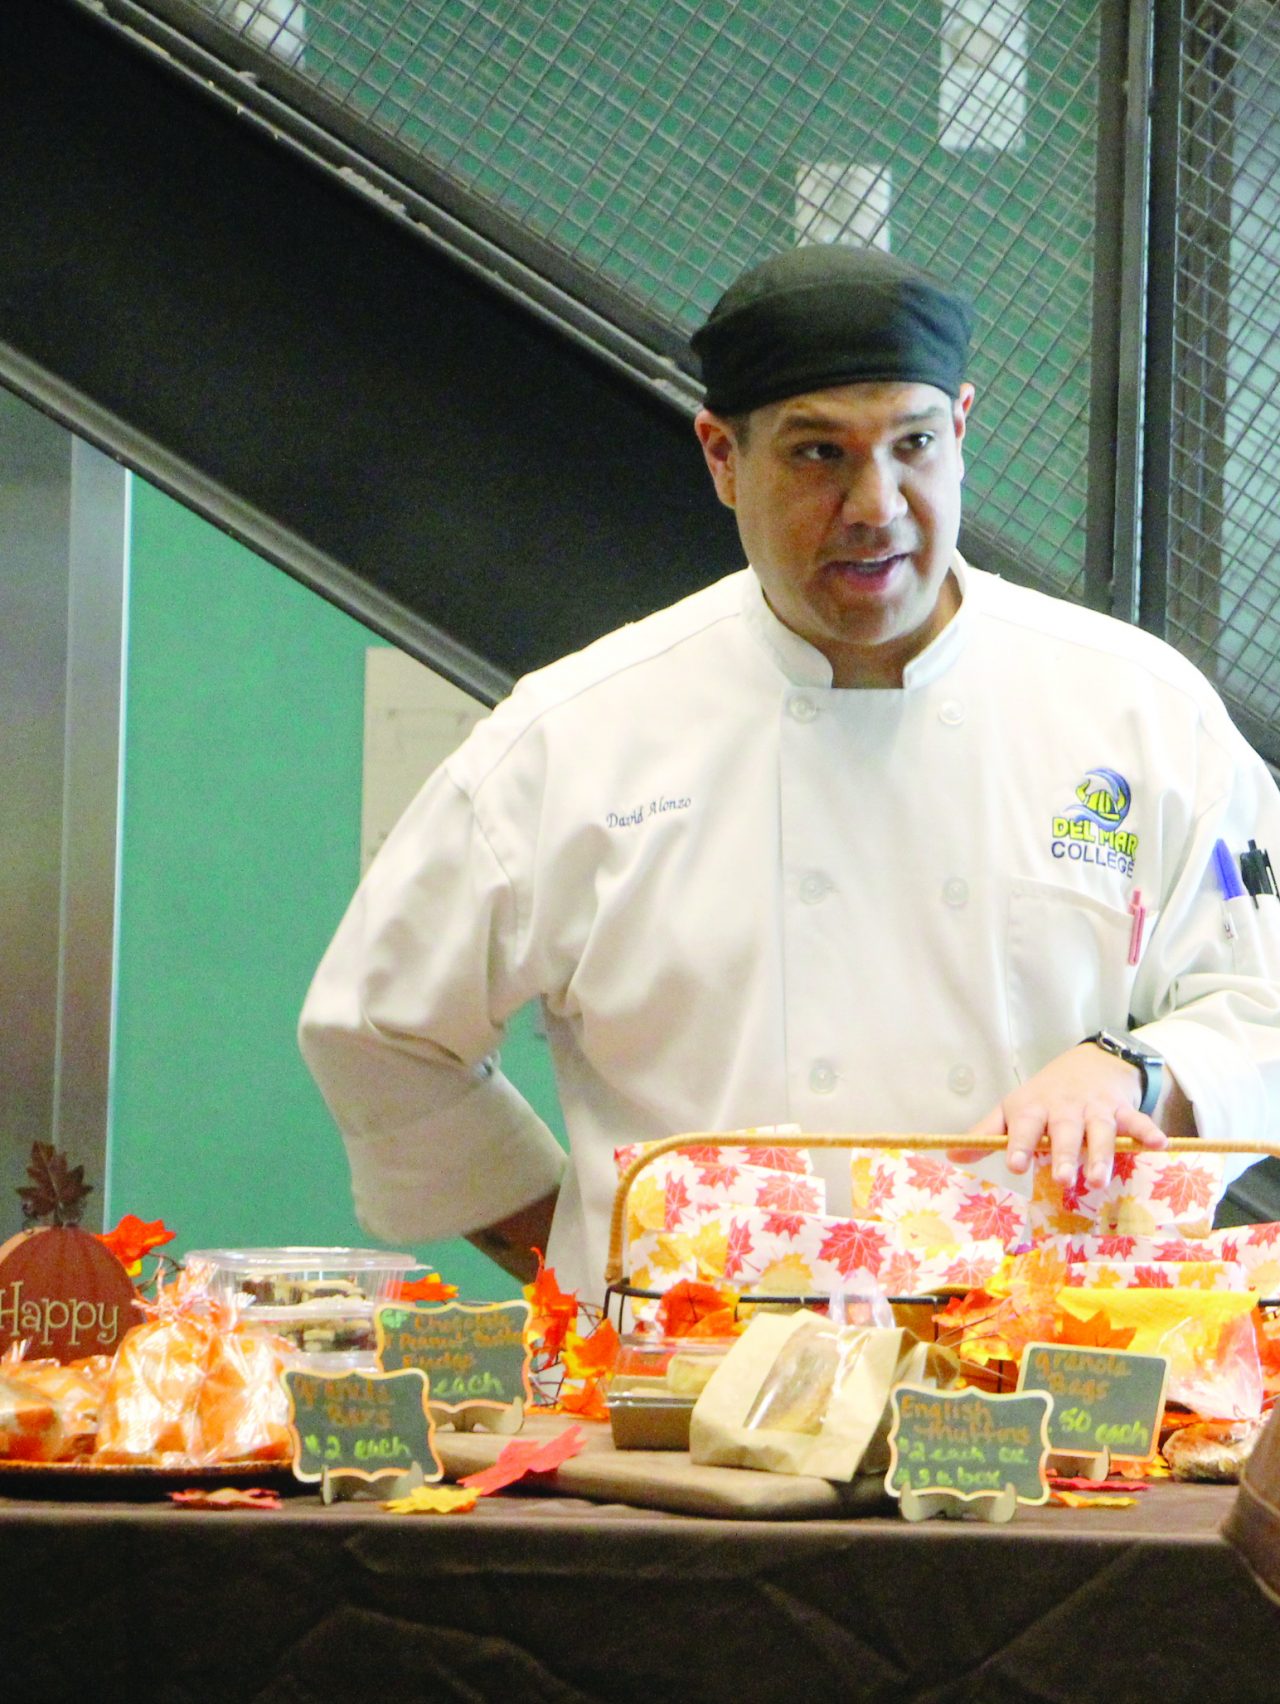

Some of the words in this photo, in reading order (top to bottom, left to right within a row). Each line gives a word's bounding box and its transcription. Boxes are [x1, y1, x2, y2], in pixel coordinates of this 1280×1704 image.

[606, 805, 644, 828] David
[648, 796, 691, 817] Alonzo
[1052, 817, 1097, 843] DEL
[1099, 829, 1139, 861] MAR
[1051, 841, 1135, 878] COLLEGE
[0, 1280, 119, 1345] Happy
[433, 1371, 504, 1397] each
[901, 1394, 994, 1431] English
[354, 1436, 412, 1461] each
[1094, 1419, 1149, 1448] each
